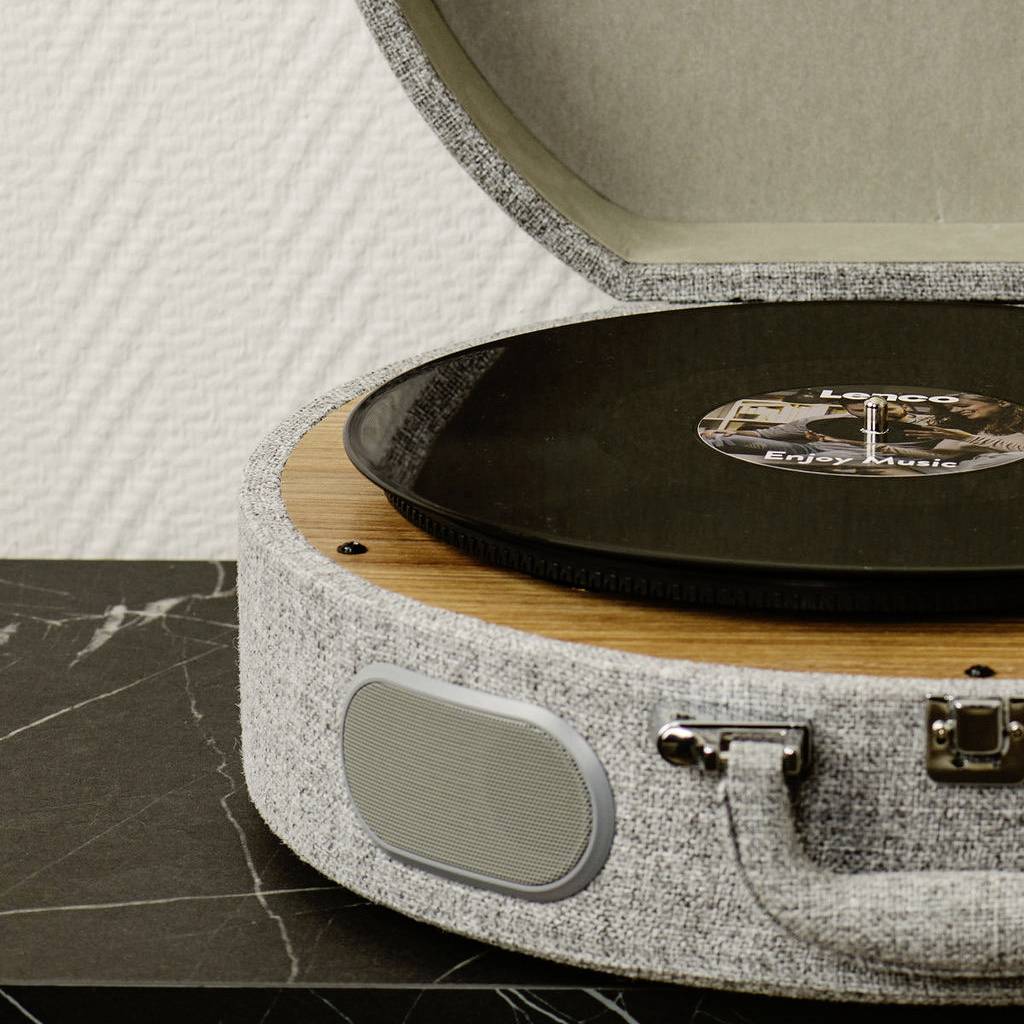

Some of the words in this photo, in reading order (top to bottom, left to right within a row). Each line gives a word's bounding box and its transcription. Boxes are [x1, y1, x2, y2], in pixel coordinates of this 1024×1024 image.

[819, 389, 960, 404] Lenco
[763, 450, 854, 466] Enjoy
[862, 455, 958, 468] Music
